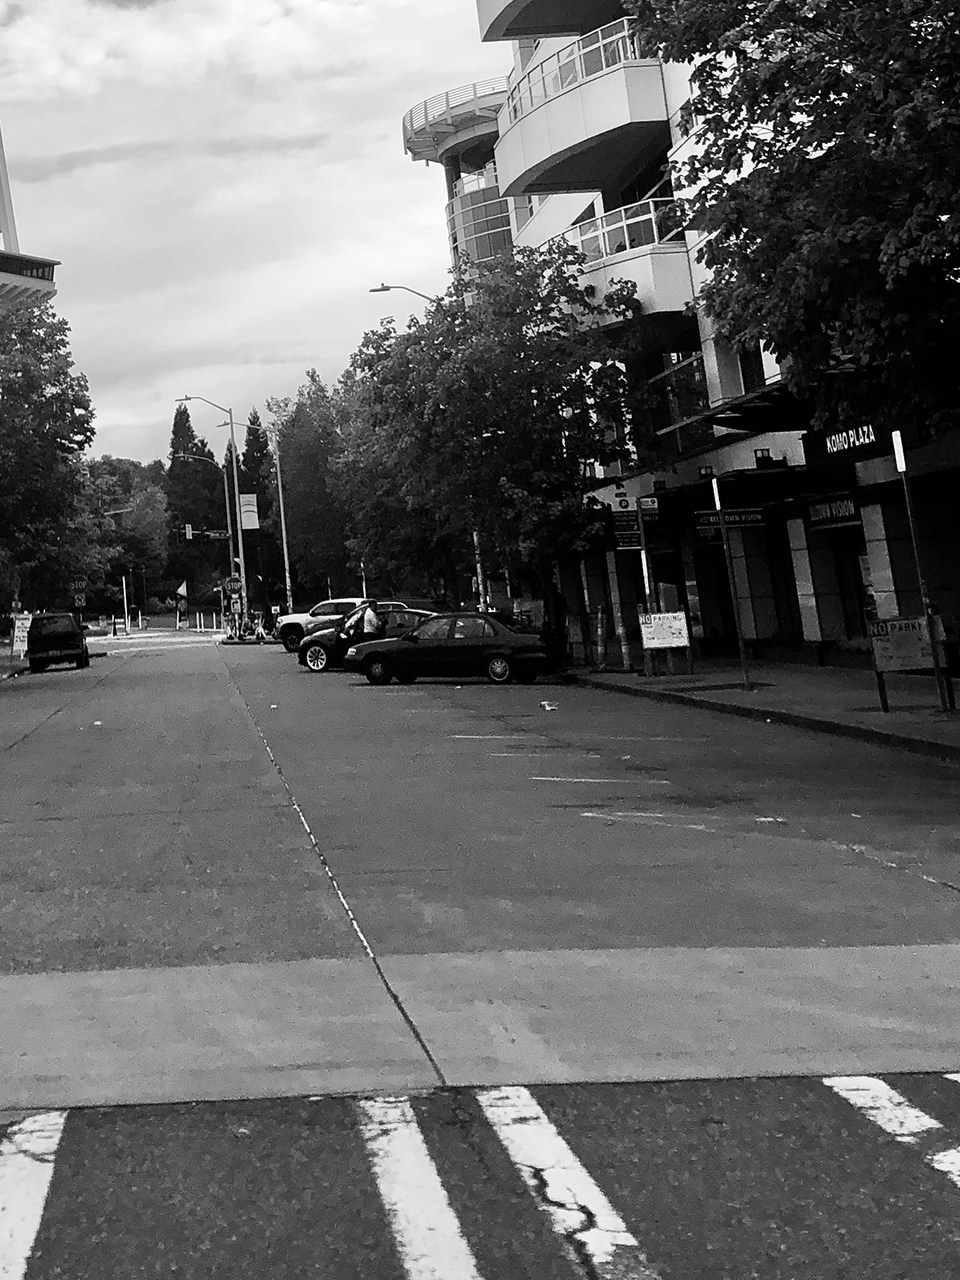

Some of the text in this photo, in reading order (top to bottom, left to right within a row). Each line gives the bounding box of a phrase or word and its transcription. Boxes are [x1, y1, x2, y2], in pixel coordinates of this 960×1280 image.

[826, 424, 876, 453] KOMO PLAZA
[71, 581, 87, 589] STOP
[227, 582, 242, 590] STOP
[640, 613, 683, 624] NO PARKING
[869, 621, 922, 635] NO PARKI
